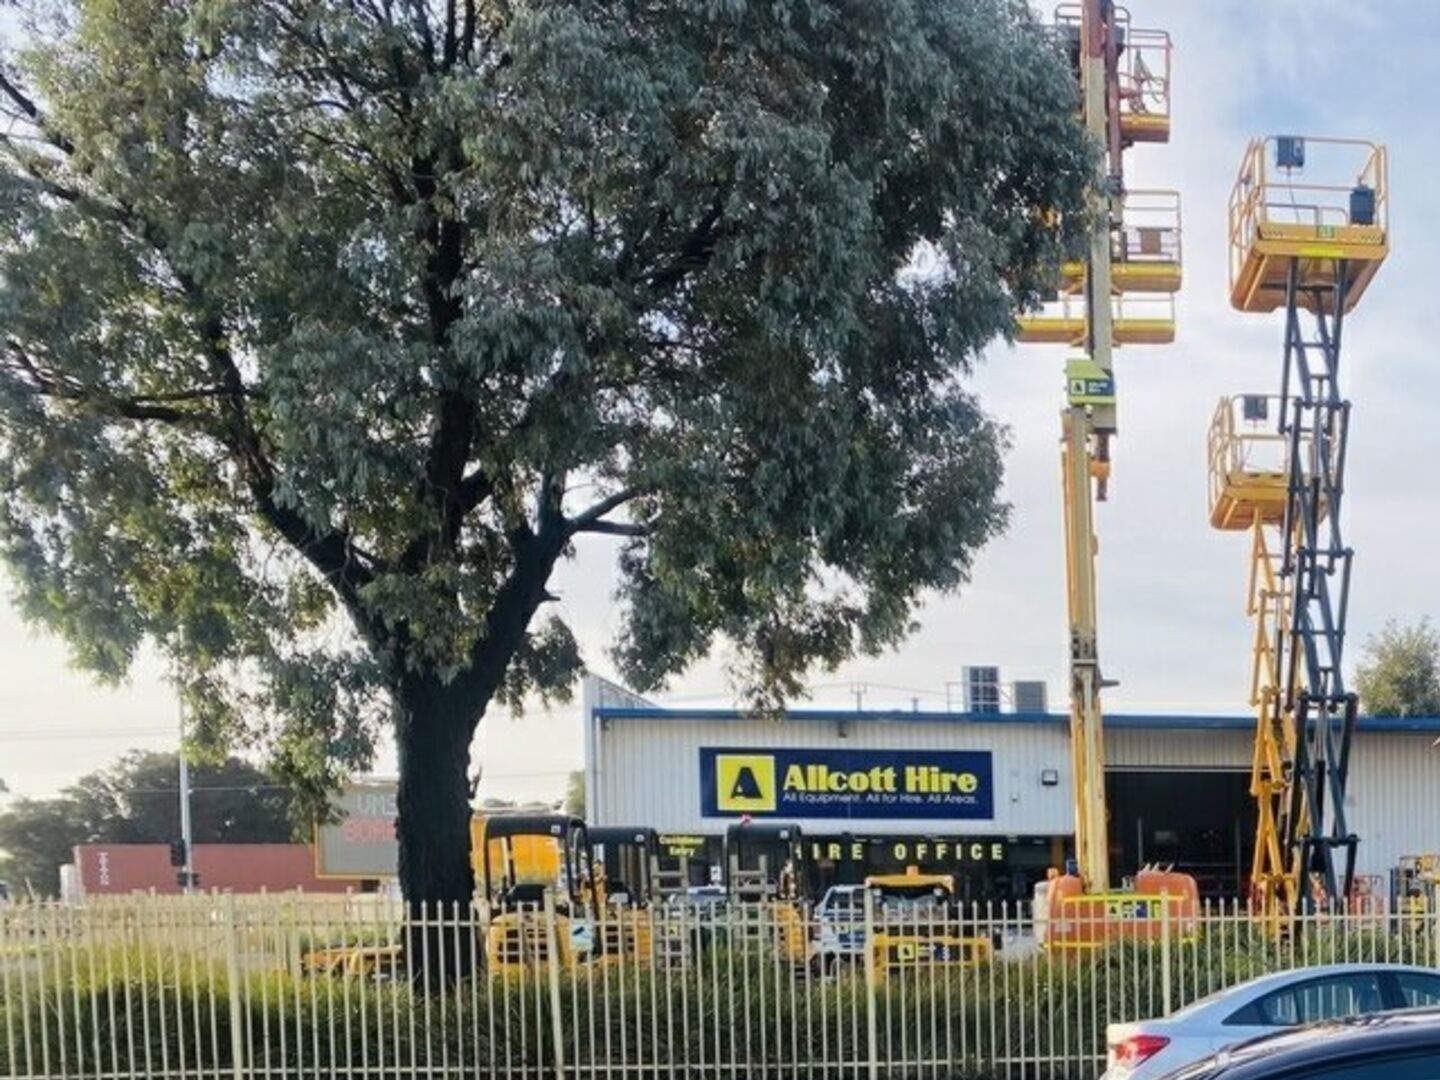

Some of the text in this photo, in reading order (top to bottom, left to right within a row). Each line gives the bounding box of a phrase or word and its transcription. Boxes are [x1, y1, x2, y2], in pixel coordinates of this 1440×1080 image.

[783, 764, 978, 793] Allcott Hire
[783, 792, 797, 803] All
[866, 793, 880, 804] All
[882, 793, 898, 805] for
[927, 794, 942, 804] All
[894, 843, 1004, 861] OFFICE
